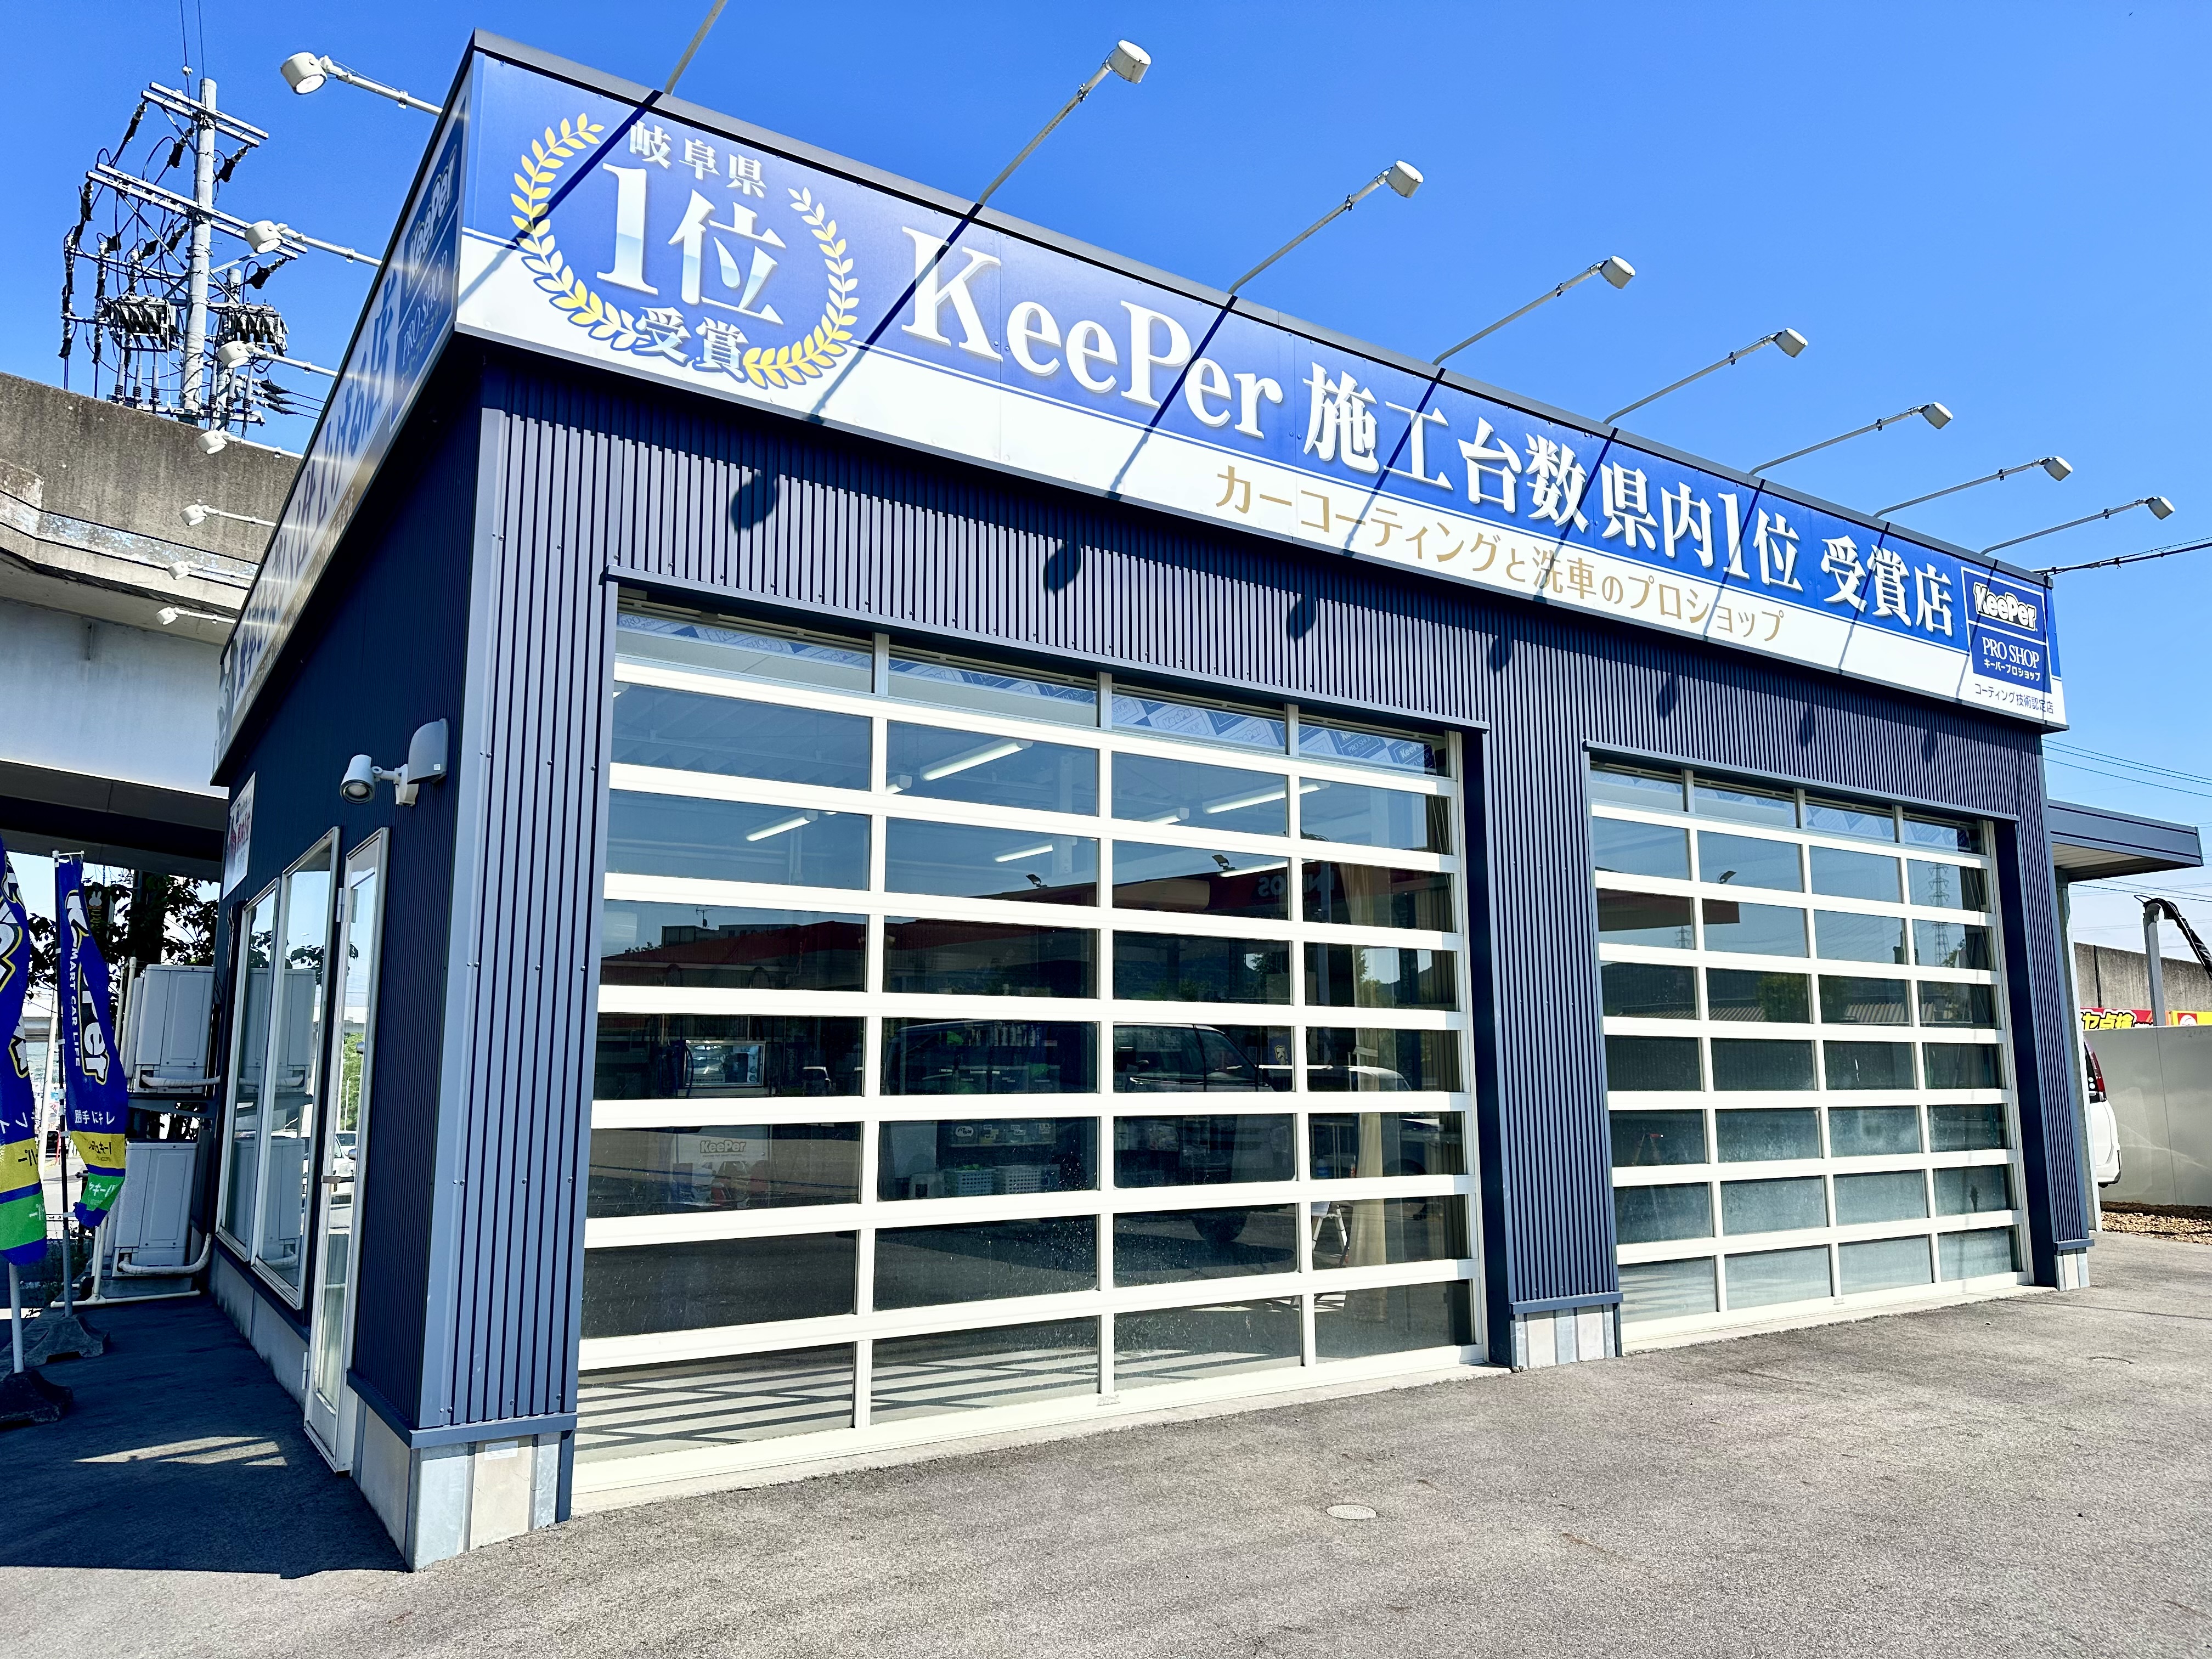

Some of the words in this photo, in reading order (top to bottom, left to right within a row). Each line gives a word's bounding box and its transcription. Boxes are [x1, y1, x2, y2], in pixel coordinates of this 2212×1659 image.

[629, 120, 767, 198] 岐阜県
[408, 150, 455, 289] KeePer
[596, 162, 787, 325] 1位
[636, 307, 748, 379] 受賞
[901, 225, 1284, 439] KeePer
[1820, 535, 1953, 637] 受賞店
[1216, 465, 1784, 642] カーコーティングと洗車のプロショップ
[1974, 582, 2036, 631] KeePer
[1982, 636, 2007, 660] PRO
[2008, 645, 2040, 669] SHOP
[1984, 658, 2041, 681] キーパープロショップ
[1975, 683, 2054, 714] コーティング技術認定店
[2082, 1012, 2134, 1030] ヤ点検
[72, 1031, 81, 1067] LIFE
[700, 1139, 746, 1153] KeePer
